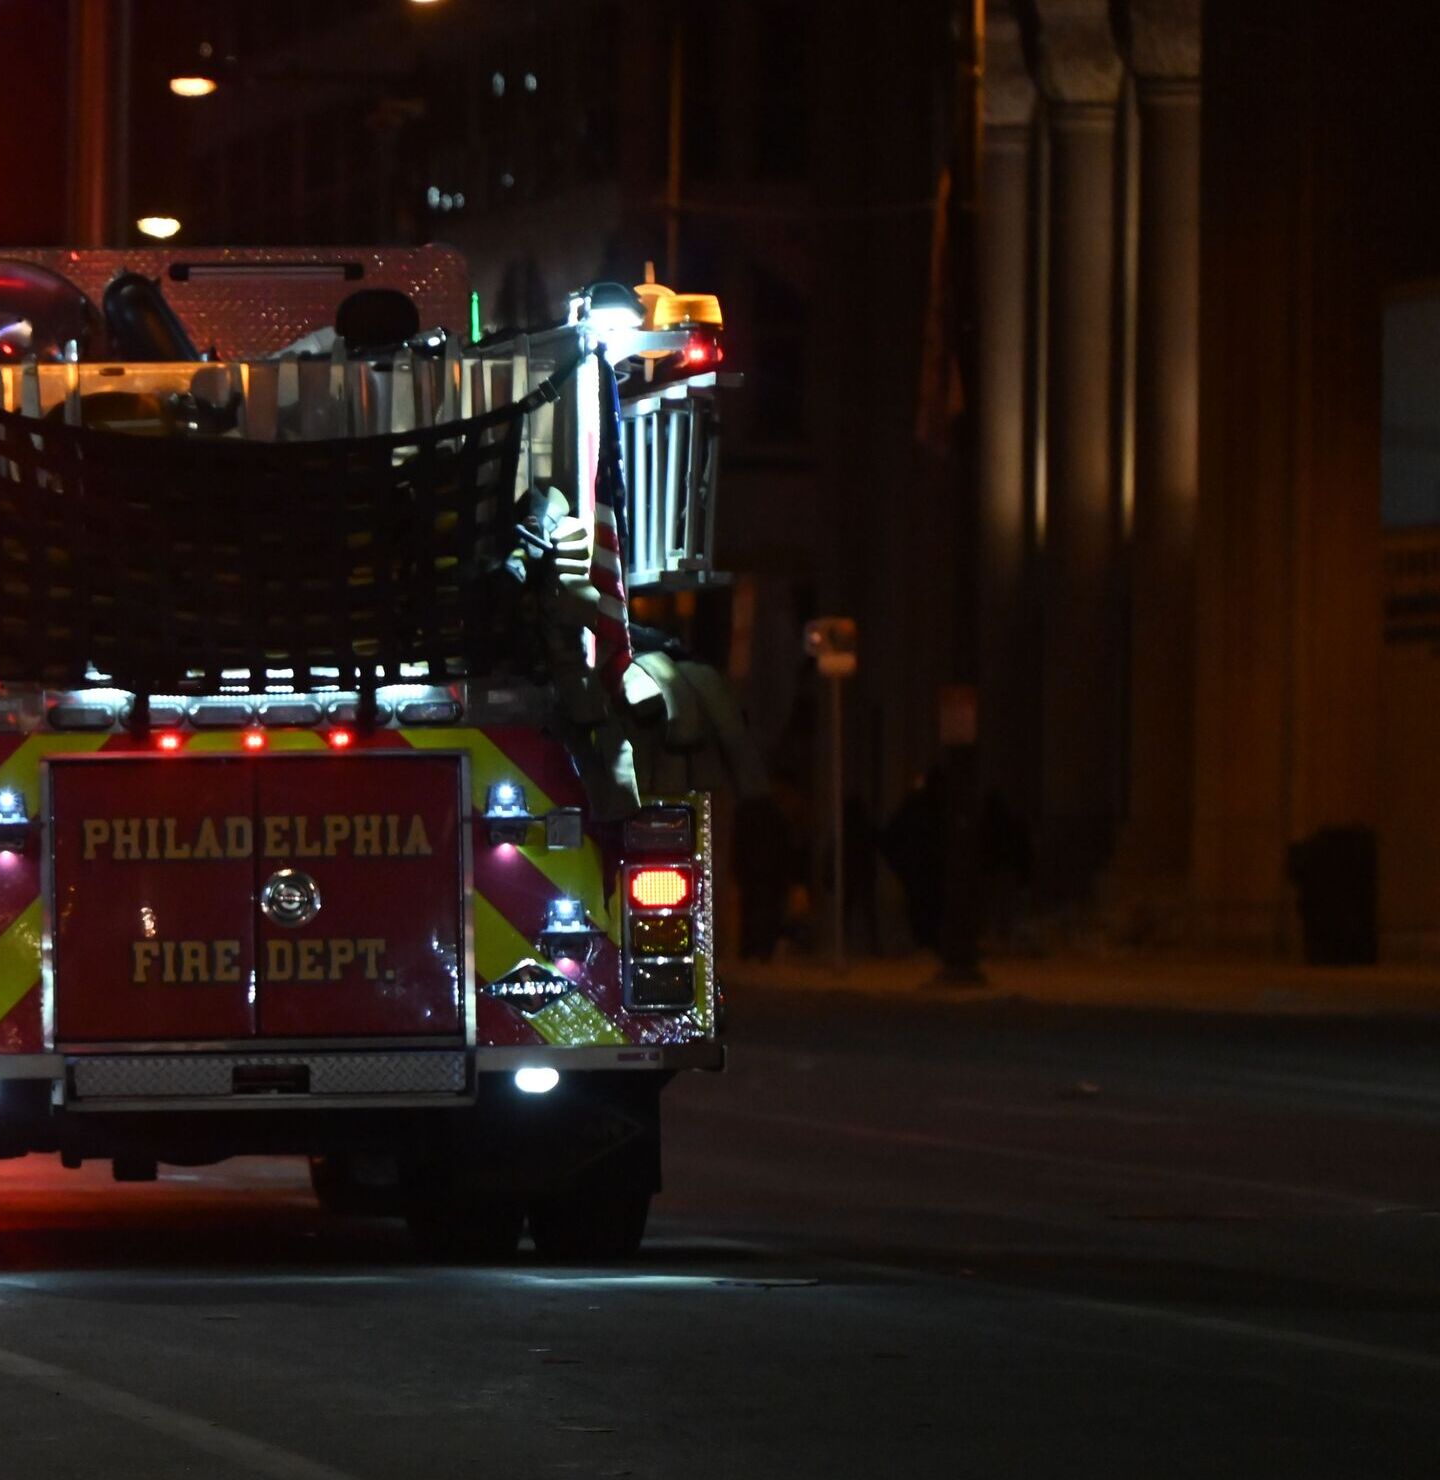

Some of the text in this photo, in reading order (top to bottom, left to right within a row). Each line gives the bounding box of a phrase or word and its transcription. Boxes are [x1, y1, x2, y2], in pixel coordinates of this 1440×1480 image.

[83, 814, 432, 860] PHILADELPHIA
[132, 938, 395, 982] FIRE DEPT.
